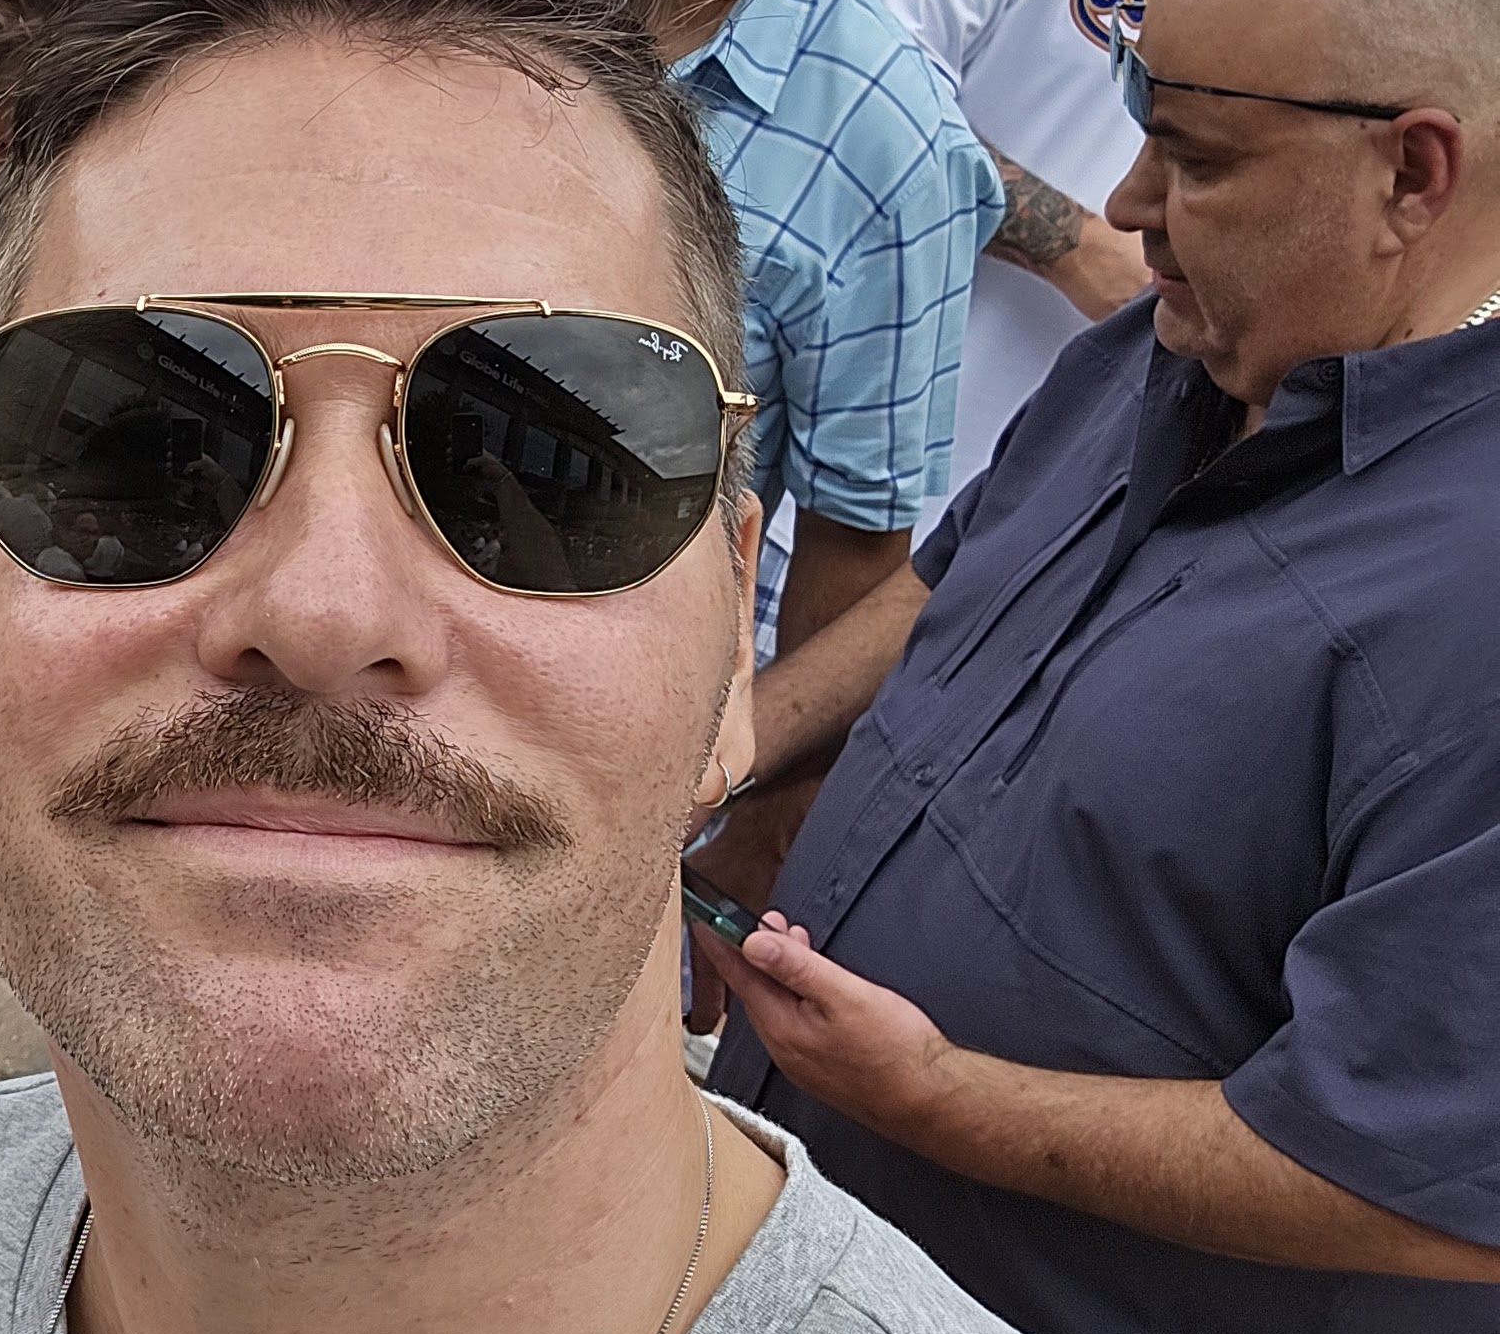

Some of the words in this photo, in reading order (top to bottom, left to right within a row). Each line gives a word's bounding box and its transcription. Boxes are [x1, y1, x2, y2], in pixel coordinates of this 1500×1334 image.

[158, 354, 198, 384] Globe
[198, 377, 221, 398] Life
[460, 350, 501, 380] Globe
[502, 373, 524, 394] Life
